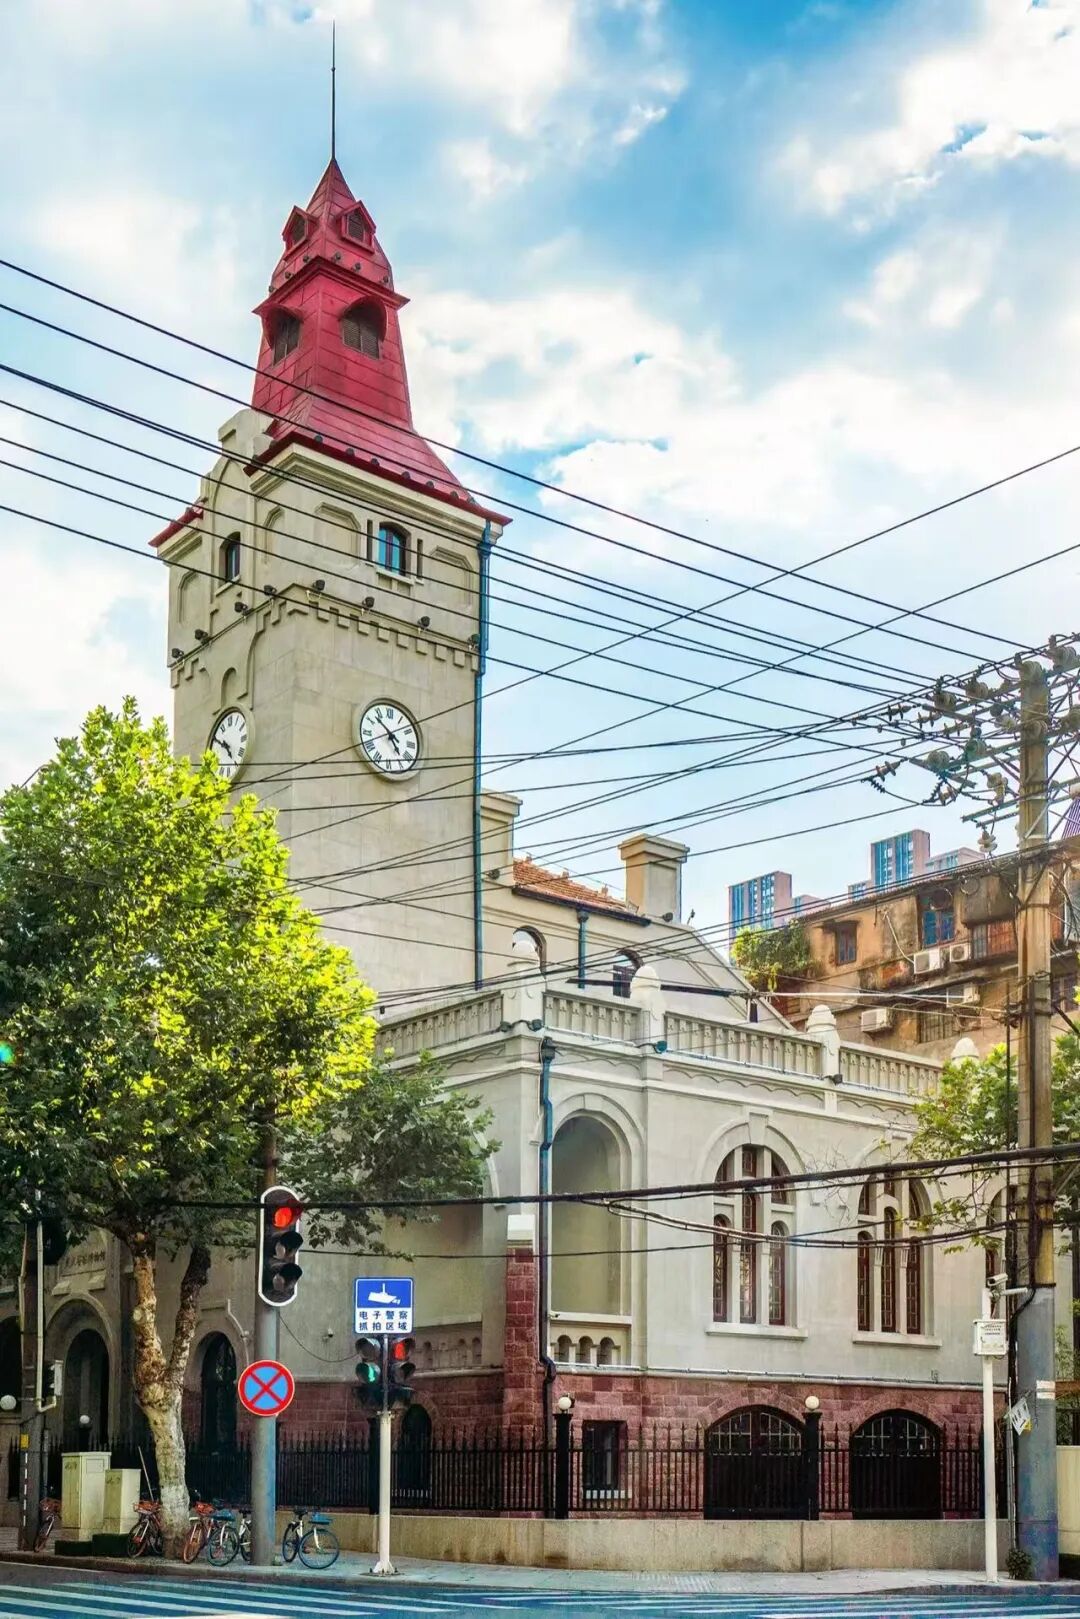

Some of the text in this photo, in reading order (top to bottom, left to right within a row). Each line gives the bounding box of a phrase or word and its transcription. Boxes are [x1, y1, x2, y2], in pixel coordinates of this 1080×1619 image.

[359, 1310, 408, 1320] 电子警察
[359, 1322, 408, 1331] 抓拍区域
